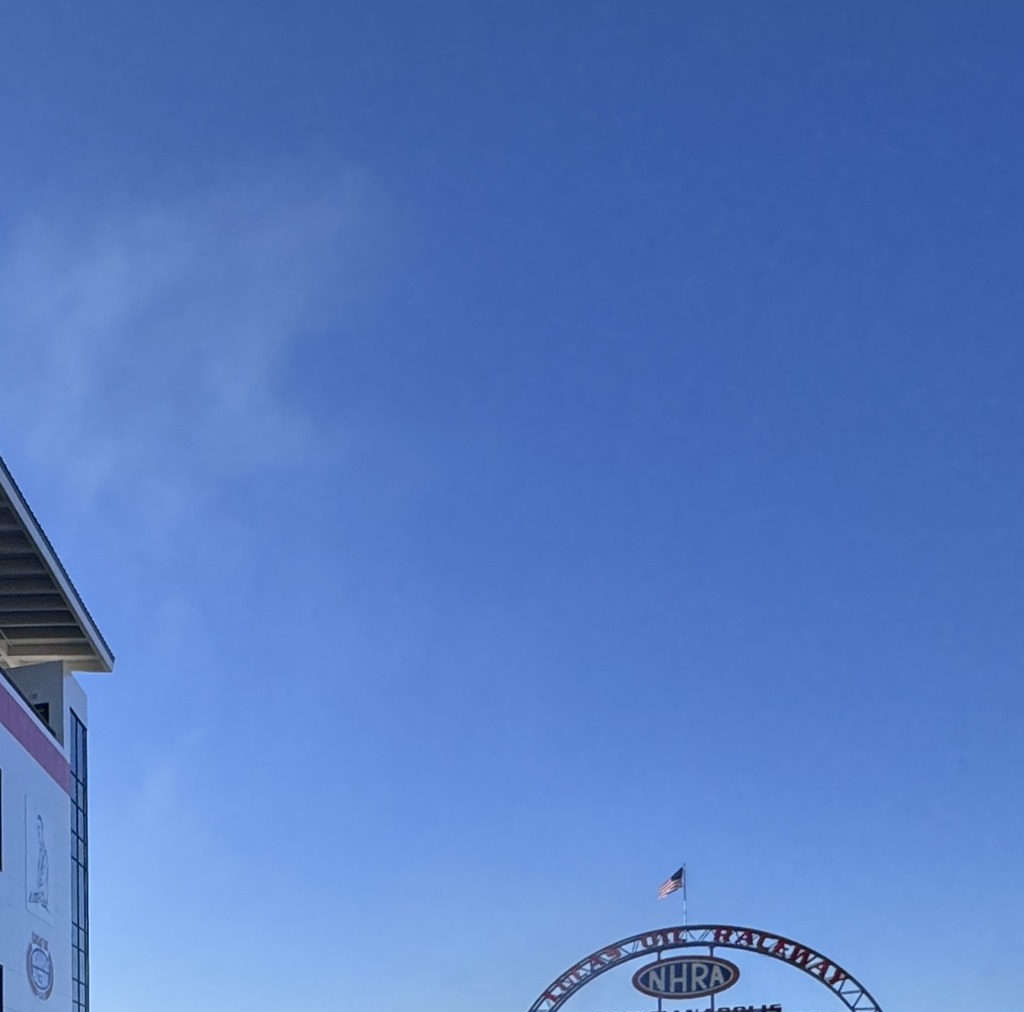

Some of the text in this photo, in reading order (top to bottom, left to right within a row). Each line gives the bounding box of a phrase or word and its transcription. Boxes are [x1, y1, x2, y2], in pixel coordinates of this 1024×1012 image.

[543, 927, 849, 1004] LUCAS OIL RACEWAY
[648, 962, 725, 993] NHRA
